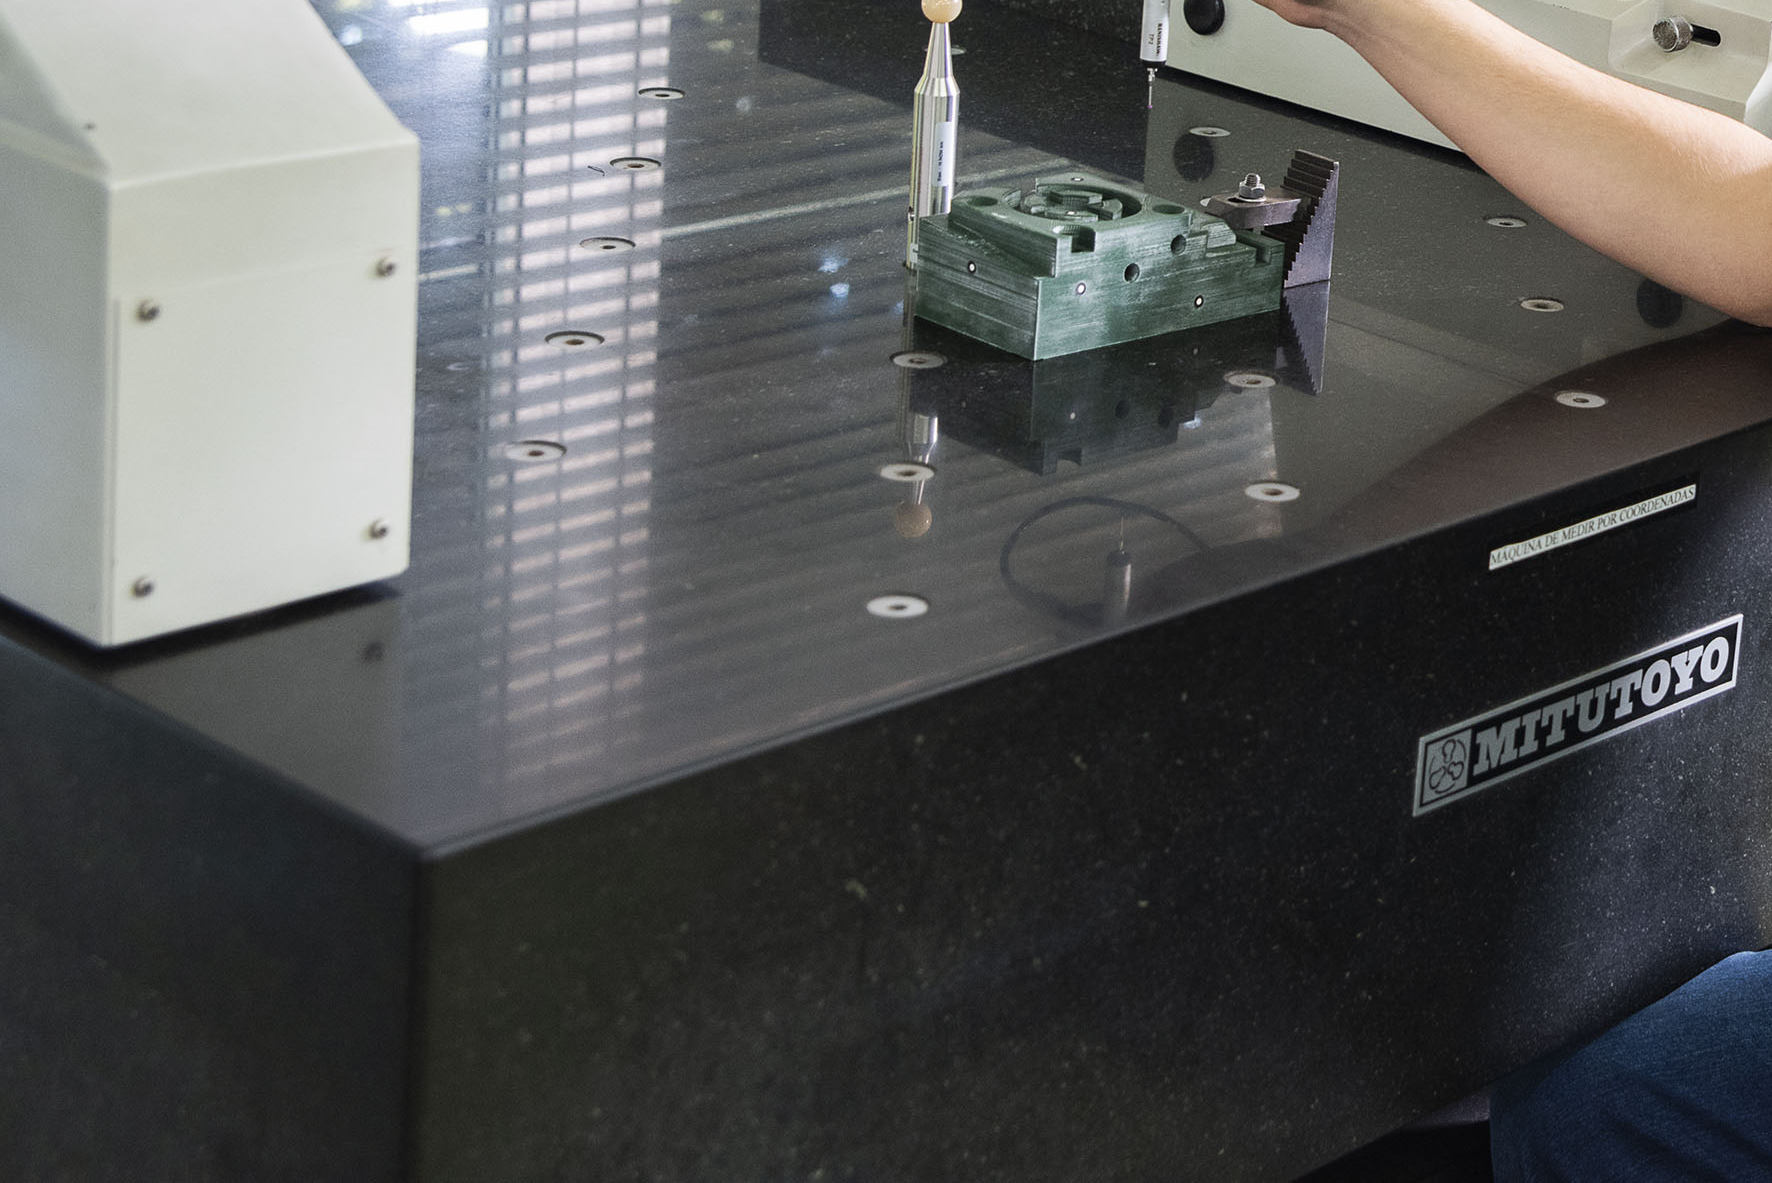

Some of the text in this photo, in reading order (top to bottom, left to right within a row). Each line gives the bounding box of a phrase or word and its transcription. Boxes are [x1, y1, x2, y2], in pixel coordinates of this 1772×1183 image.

[1545, 531, 1559, 547] DE
[1561, 520, 1595, 542] MEDIR
[1597, 513, 1617, 530] POR
[1619, 486, 1695, 522] COORDENADAS
[1473, 636, 1730, 777] MITUTOYO
